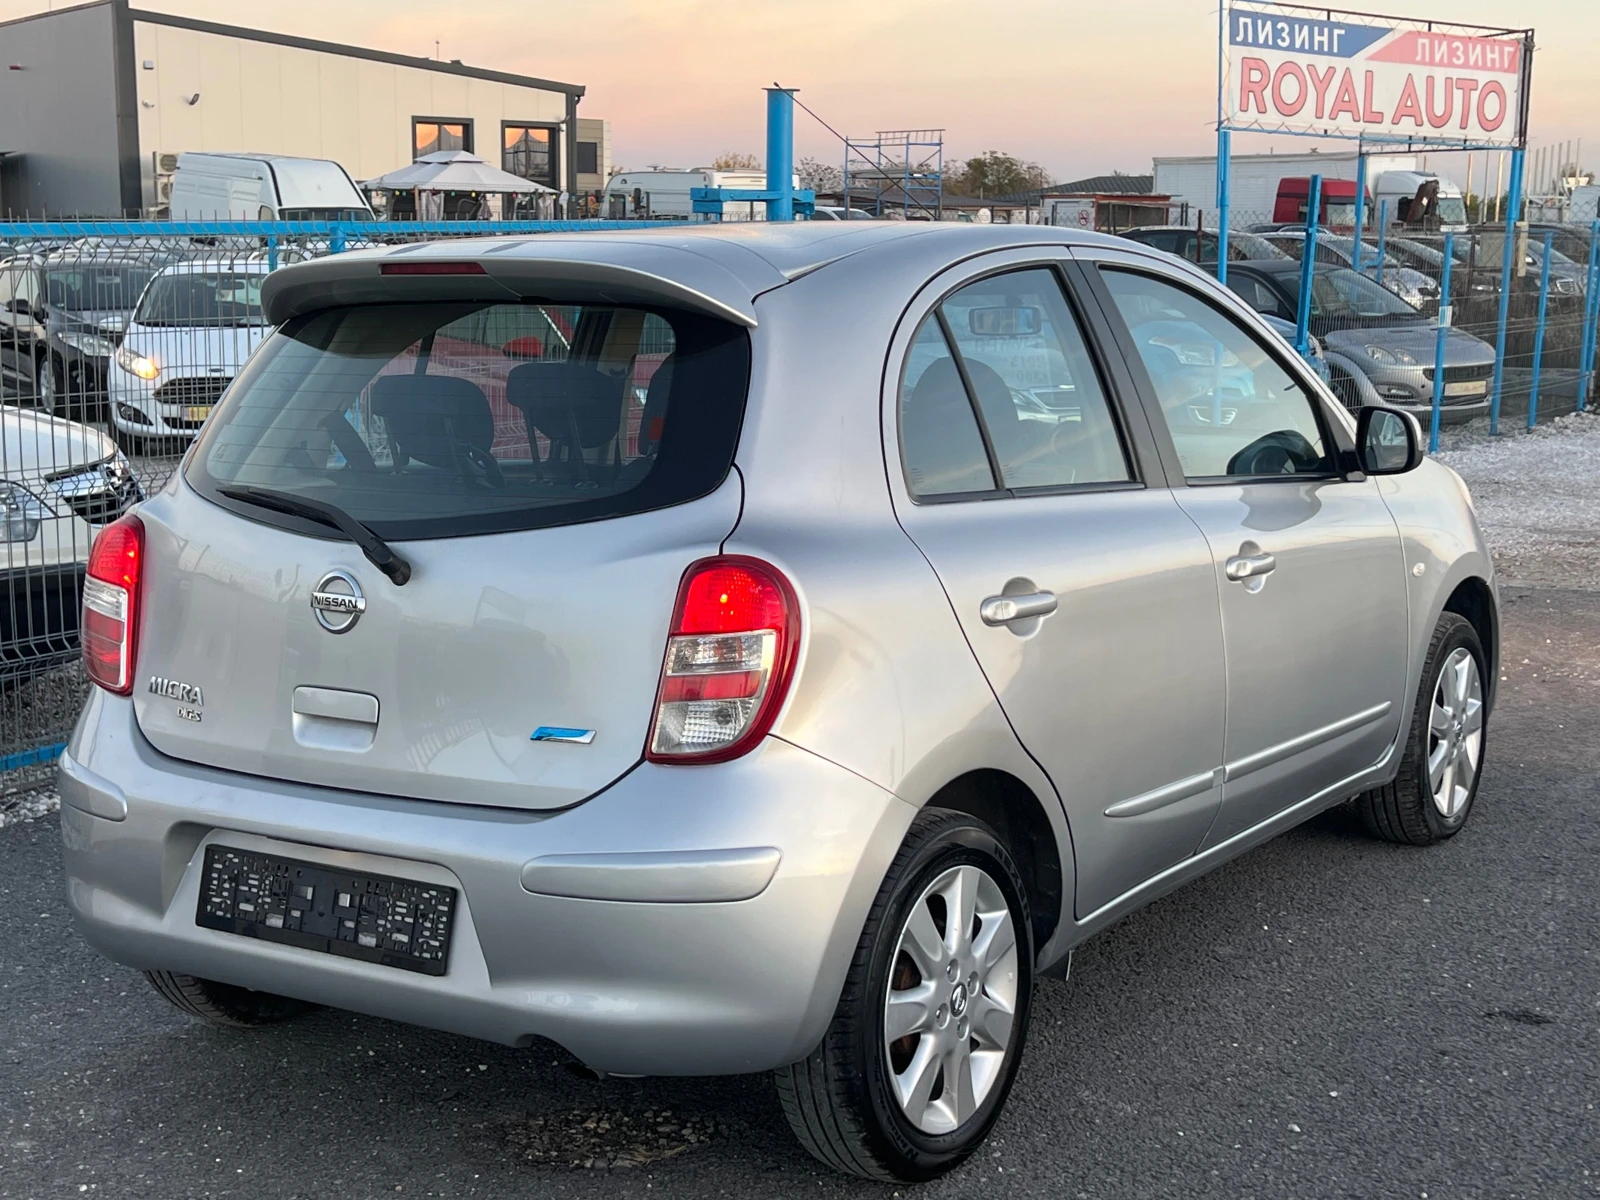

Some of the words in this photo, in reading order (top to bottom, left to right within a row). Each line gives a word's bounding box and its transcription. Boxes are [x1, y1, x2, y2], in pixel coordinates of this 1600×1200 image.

[1236, 16, 1346, 53] ЛИЗИНГ
[1415, 38, 1515, 69] ЛИЗИНГ
[1239, 56, 1384, 124] ROYAL
[1391, 73, 1507, 132] AUTO
[314, 595, 358, 609] NISSAN
[148, 676, 204, 706] MICRA
